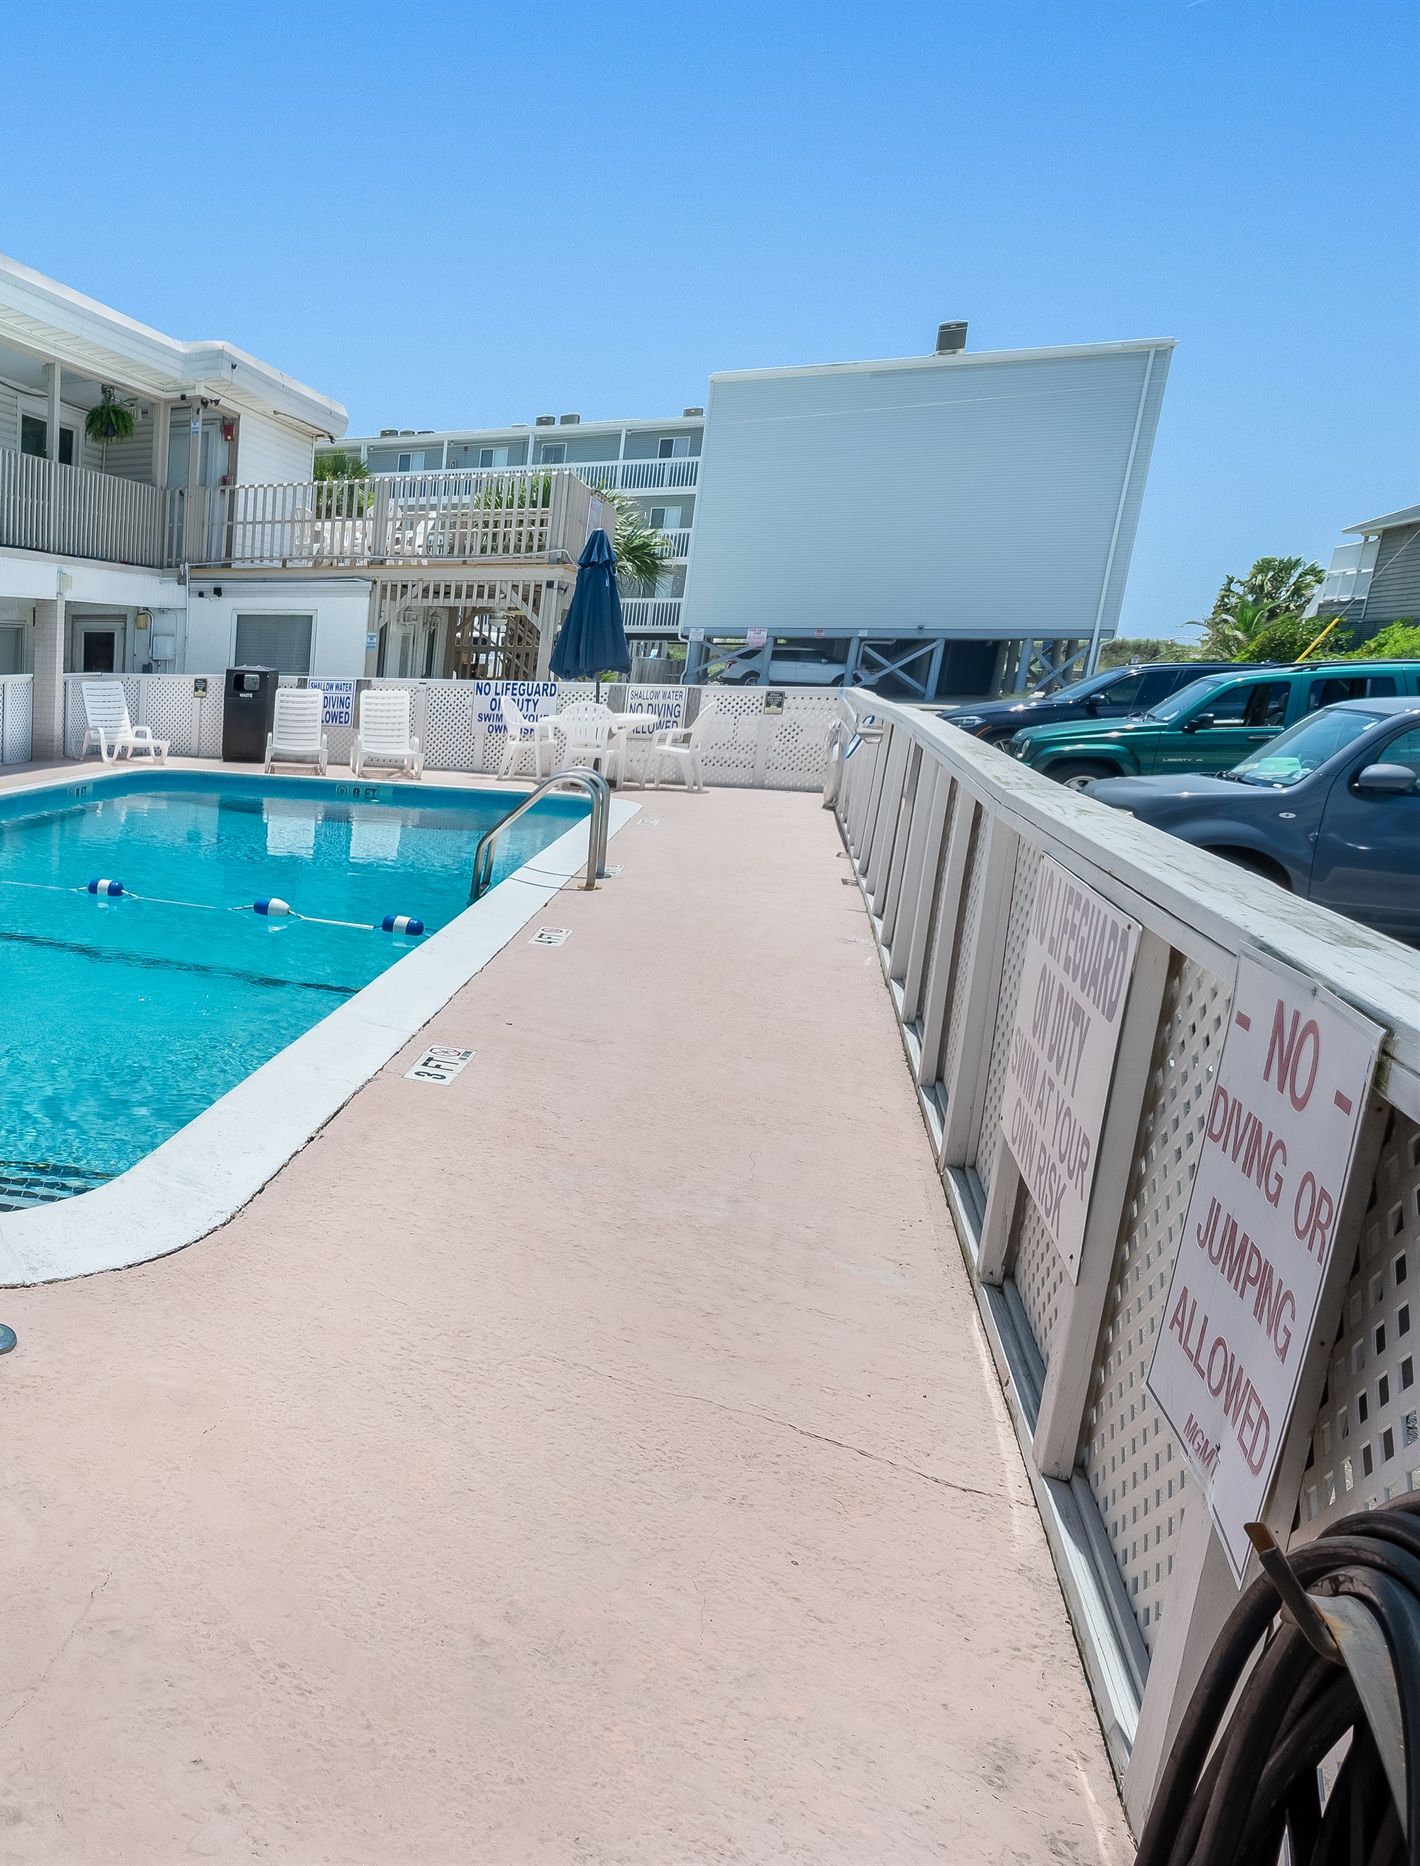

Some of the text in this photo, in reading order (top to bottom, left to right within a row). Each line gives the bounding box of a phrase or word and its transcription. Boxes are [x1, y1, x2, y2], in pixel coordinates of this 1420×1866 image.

[311, 682, 352, 692] SHALLOW WATER
[475, 682, 557, 697] NO LIFEGUARD
[630, 690, 683, 700] SHALLOW WATER
[323, 695, 350, 709] DIVING
[489, 698, 500, 712] O
[629, 702, 681, 719] NO DIVING
[322, 711, 350, 724] OWED
[477, 713, 503, 723] SWIM
[487, 724, 508, 734] OWN
[632, 720, 679, 734] LLOWED
[1032, 865, 1129, 1024] NO LIFEGUARD
[1033, 961, 1092, 1099] ON DUTY
[1263, 998, 1321, 1112] NO
[414, 1057, 459, 1080] 3 FT
[1011, 1027, 1091, 1203] SWIM AT YOUR
[1011, 1096, 1068, 1241] OWN RISK
[1206, 1084, 1335, 1265] DIVING OR
[1196, 1196, 1297, 1364] JUMPING
[1168, 1285, 1271, 1477] ALLOWED
